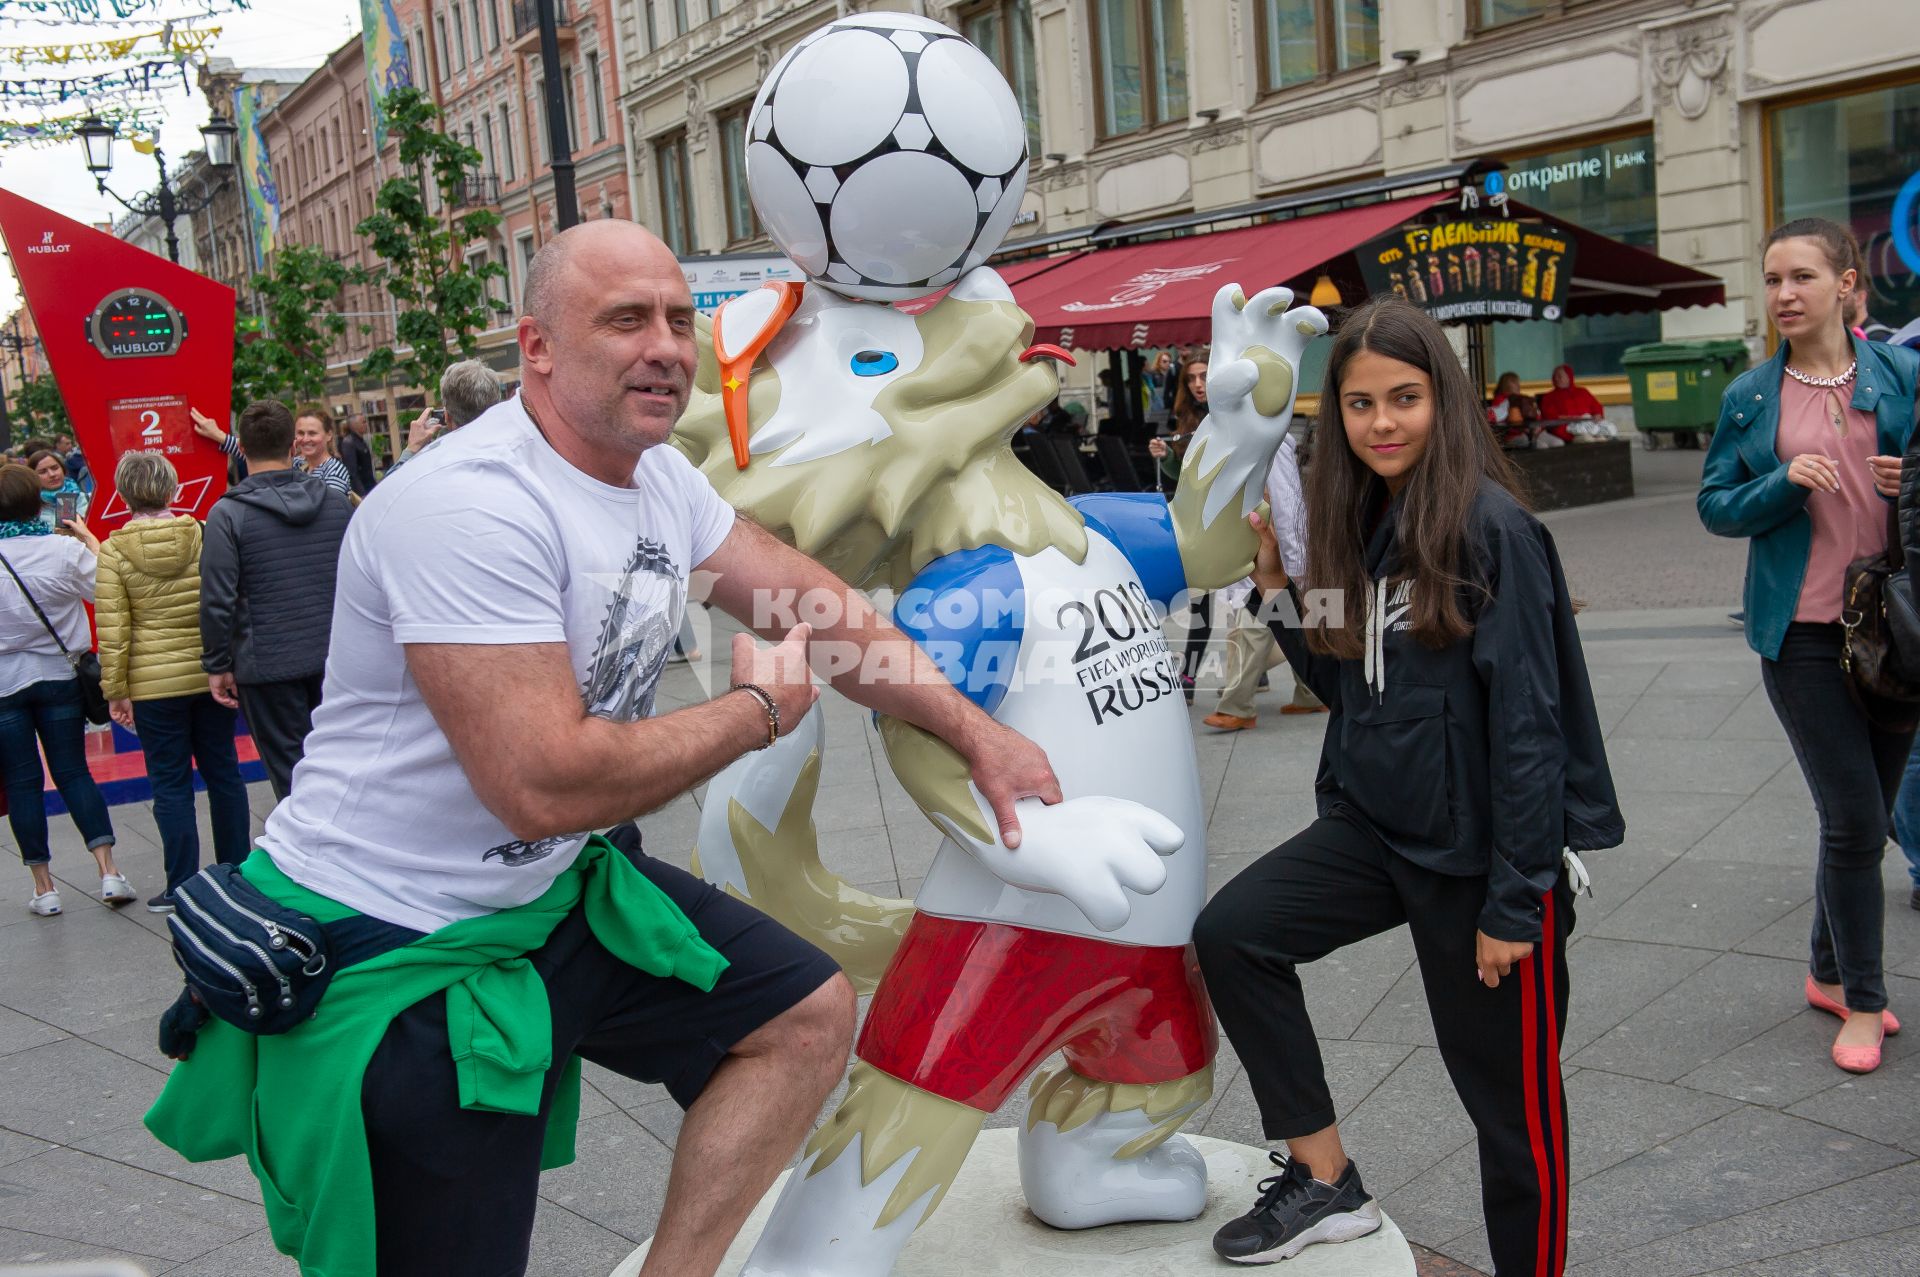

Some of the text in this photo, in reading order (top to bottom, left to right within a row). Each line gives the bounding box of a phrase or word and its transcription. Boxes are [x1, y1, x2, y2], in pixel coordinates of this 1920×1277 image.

[1508, 151, 1646, 191] открытие БАНК
[28, 245, 70, 254] HUBLOT
[127, 298, 140, 306] 12
[113, 341, 166, 355] HUBLOT
[140, 410, 163, 436] 2
[1056, 581, 1162, 665] 2018
[1076, 657, 1118, 688] FIFA
[1116, 637, 1159, 668] WORLD
